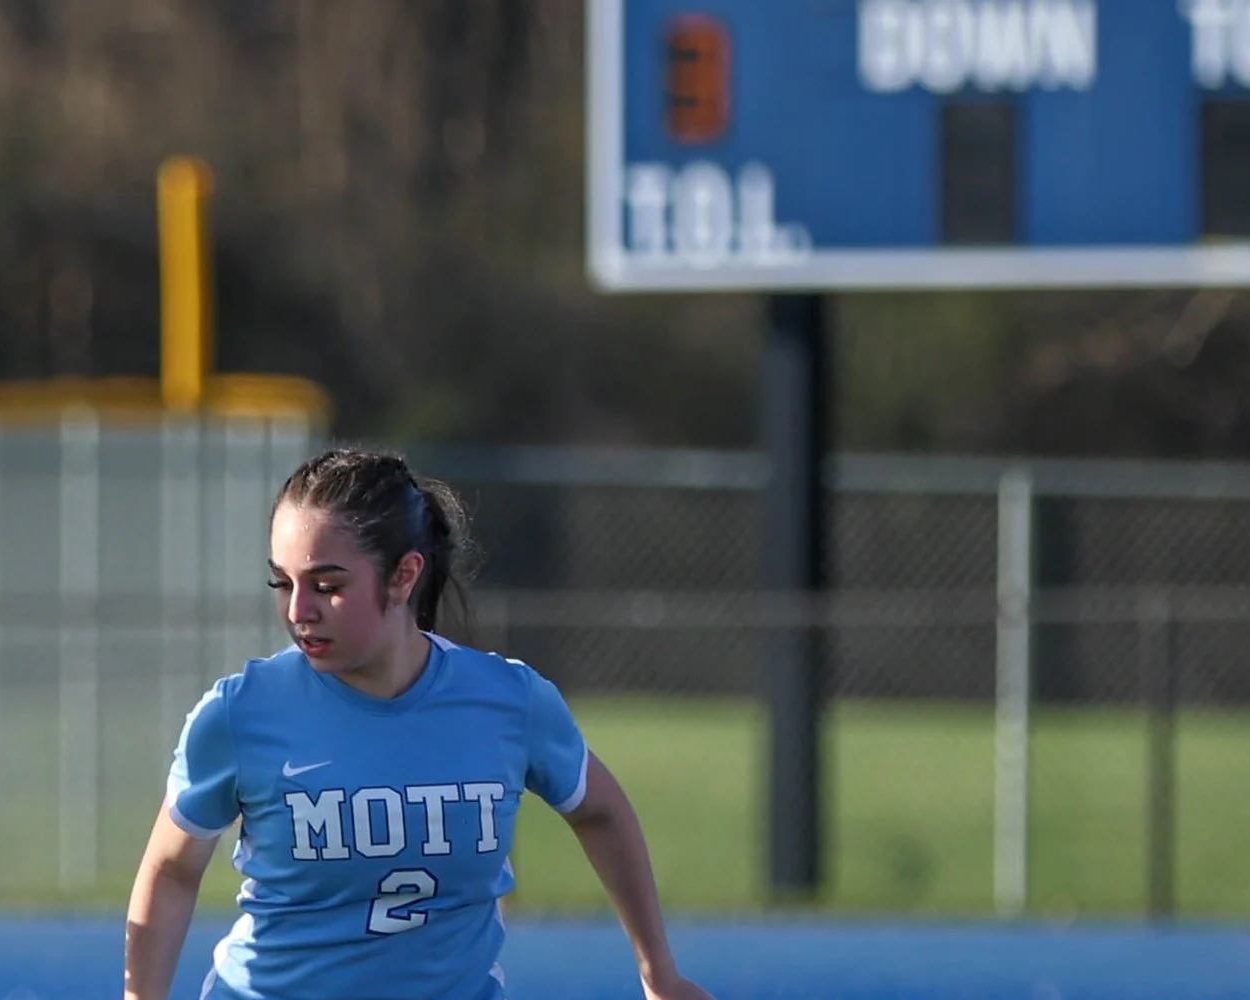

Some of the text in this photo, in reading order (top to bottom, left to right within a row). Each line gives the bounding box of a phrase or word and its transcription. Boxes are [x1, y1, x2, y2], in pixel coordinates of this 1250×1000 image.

[857, 0, 1097, 91] DOWN
[284, 780, 505, 861] MOTT
[366, 867, 438, 935] 2
